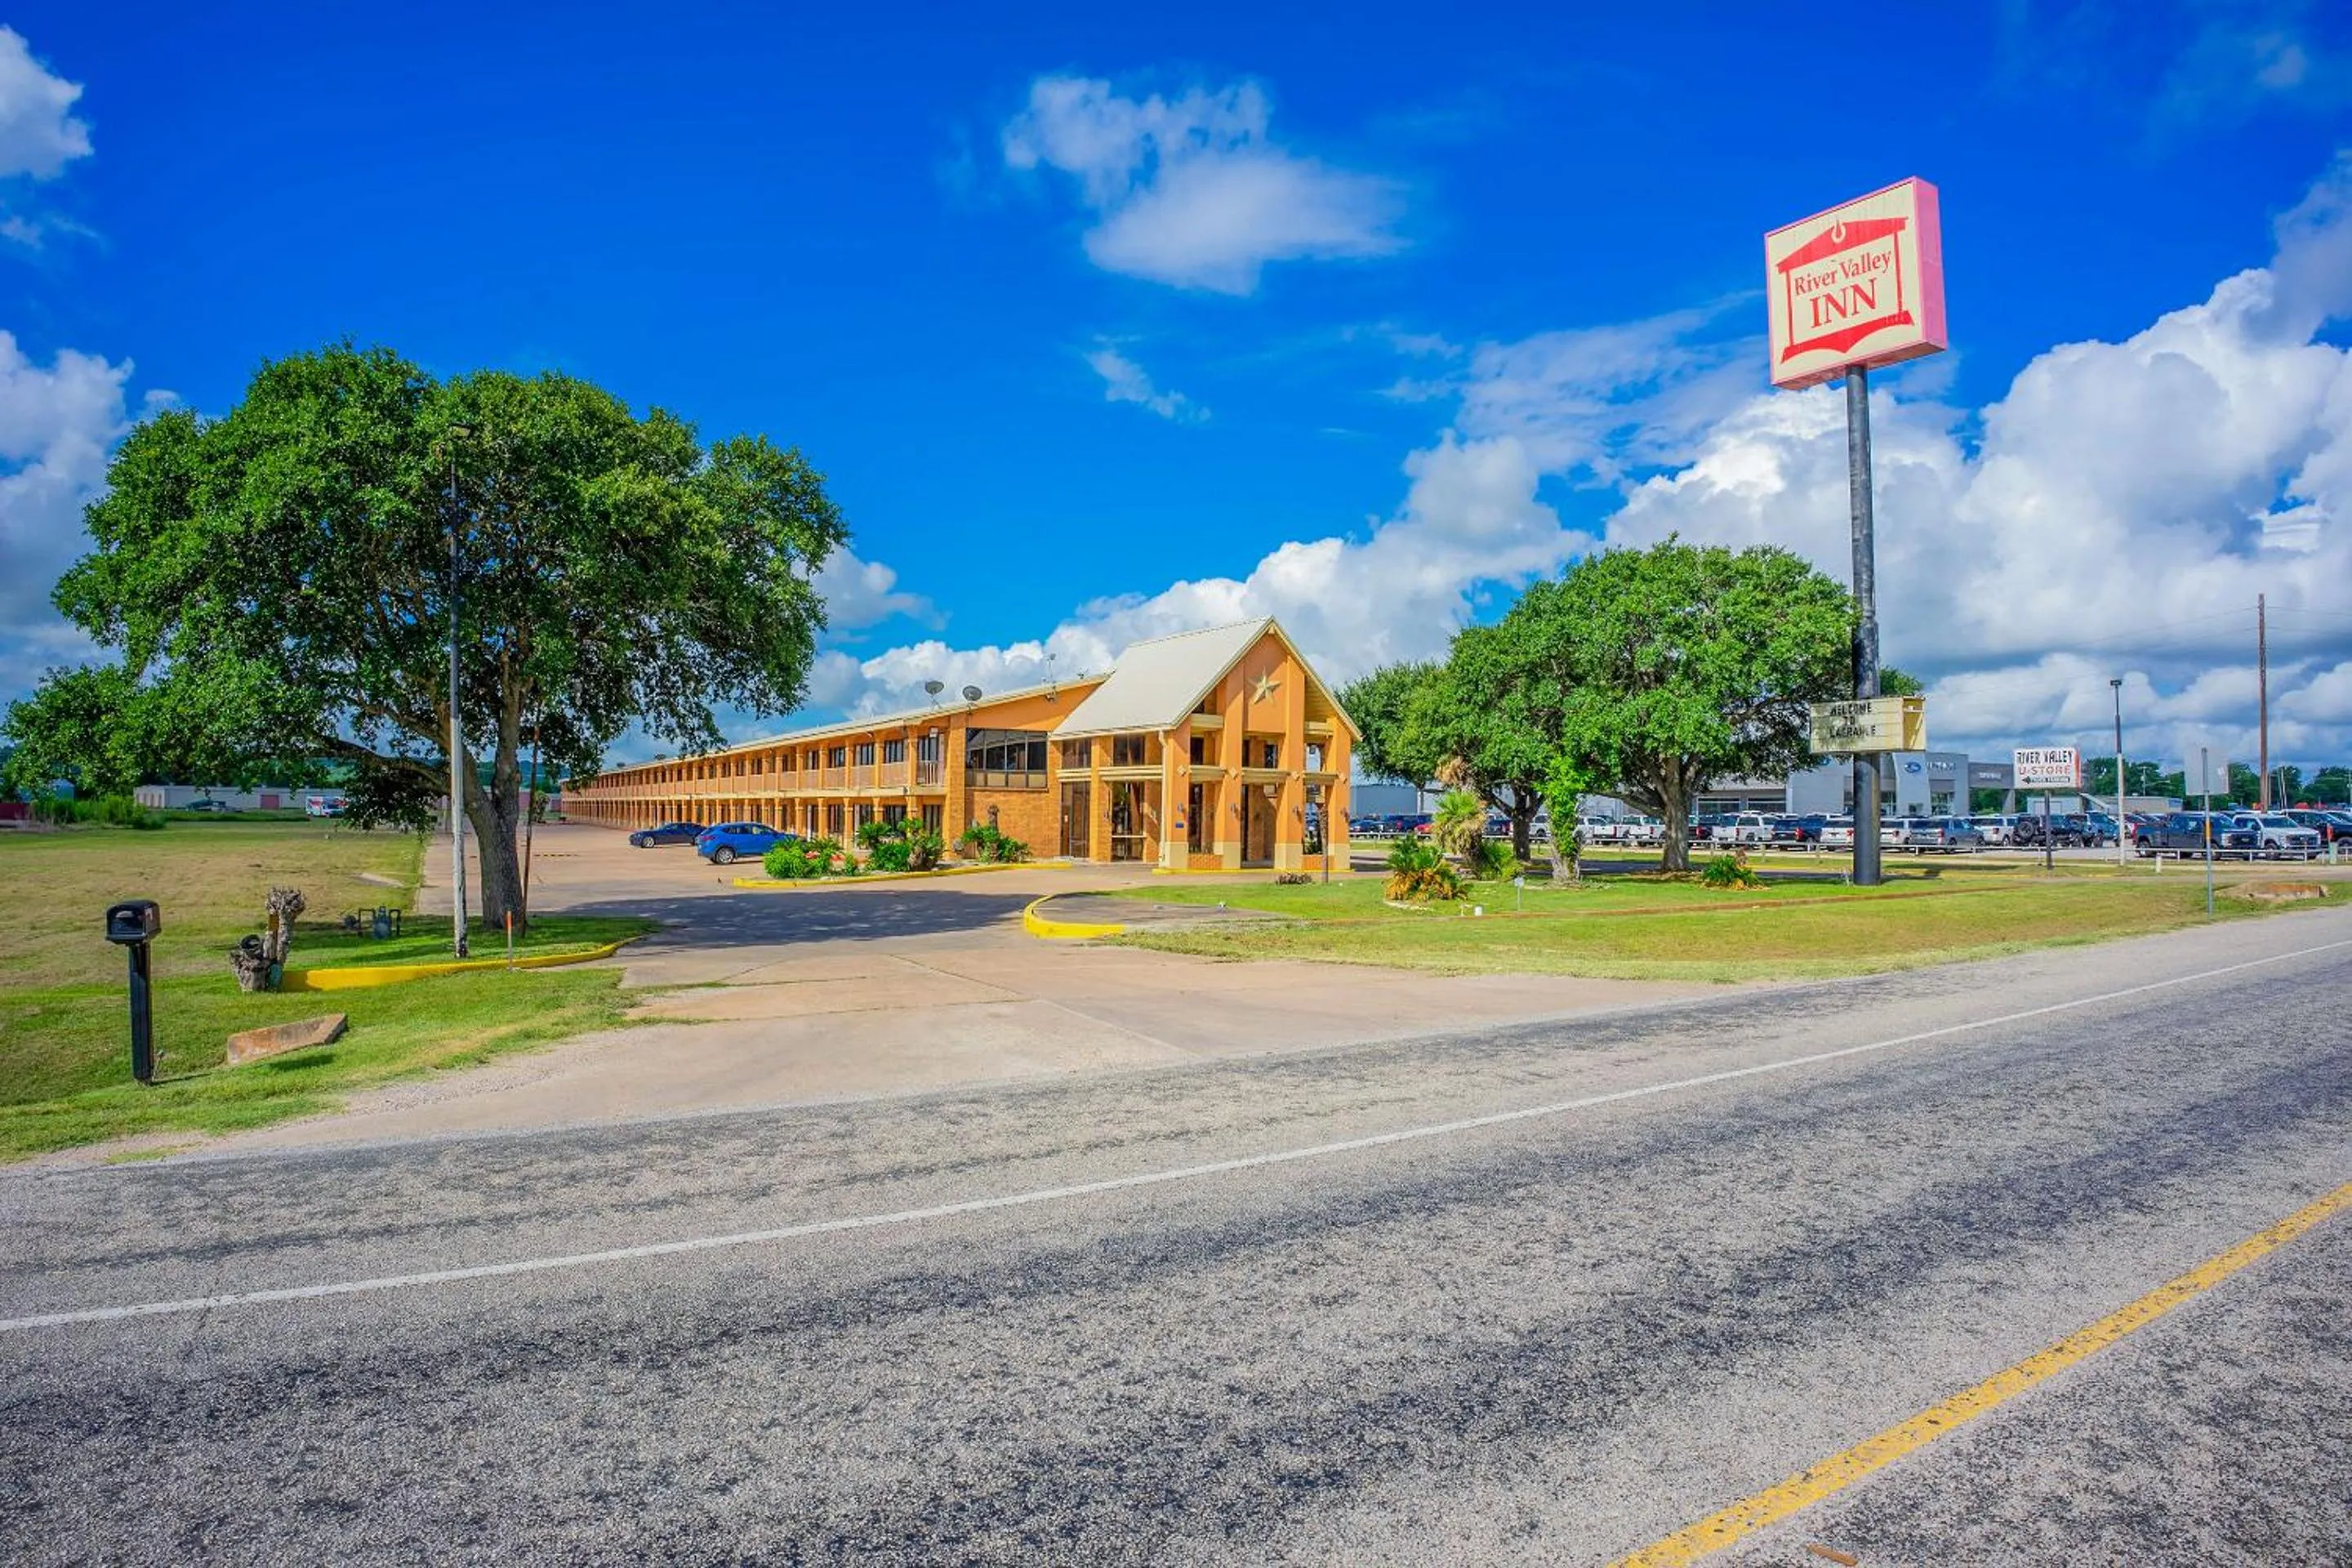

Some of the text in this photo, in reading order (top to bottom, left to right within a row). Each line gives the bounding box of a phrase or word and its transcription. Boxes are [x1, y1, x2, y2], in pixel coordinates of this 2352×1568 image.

[1794, 250, 1892, 296] River Valley
[1809, 278, 1878, 328] INN
[1830, 702, 1872, 716] WELCOME
[1843, 716, 1855, 725] TO
[2016, 751, 2073, 764] RIVER VALLEY
